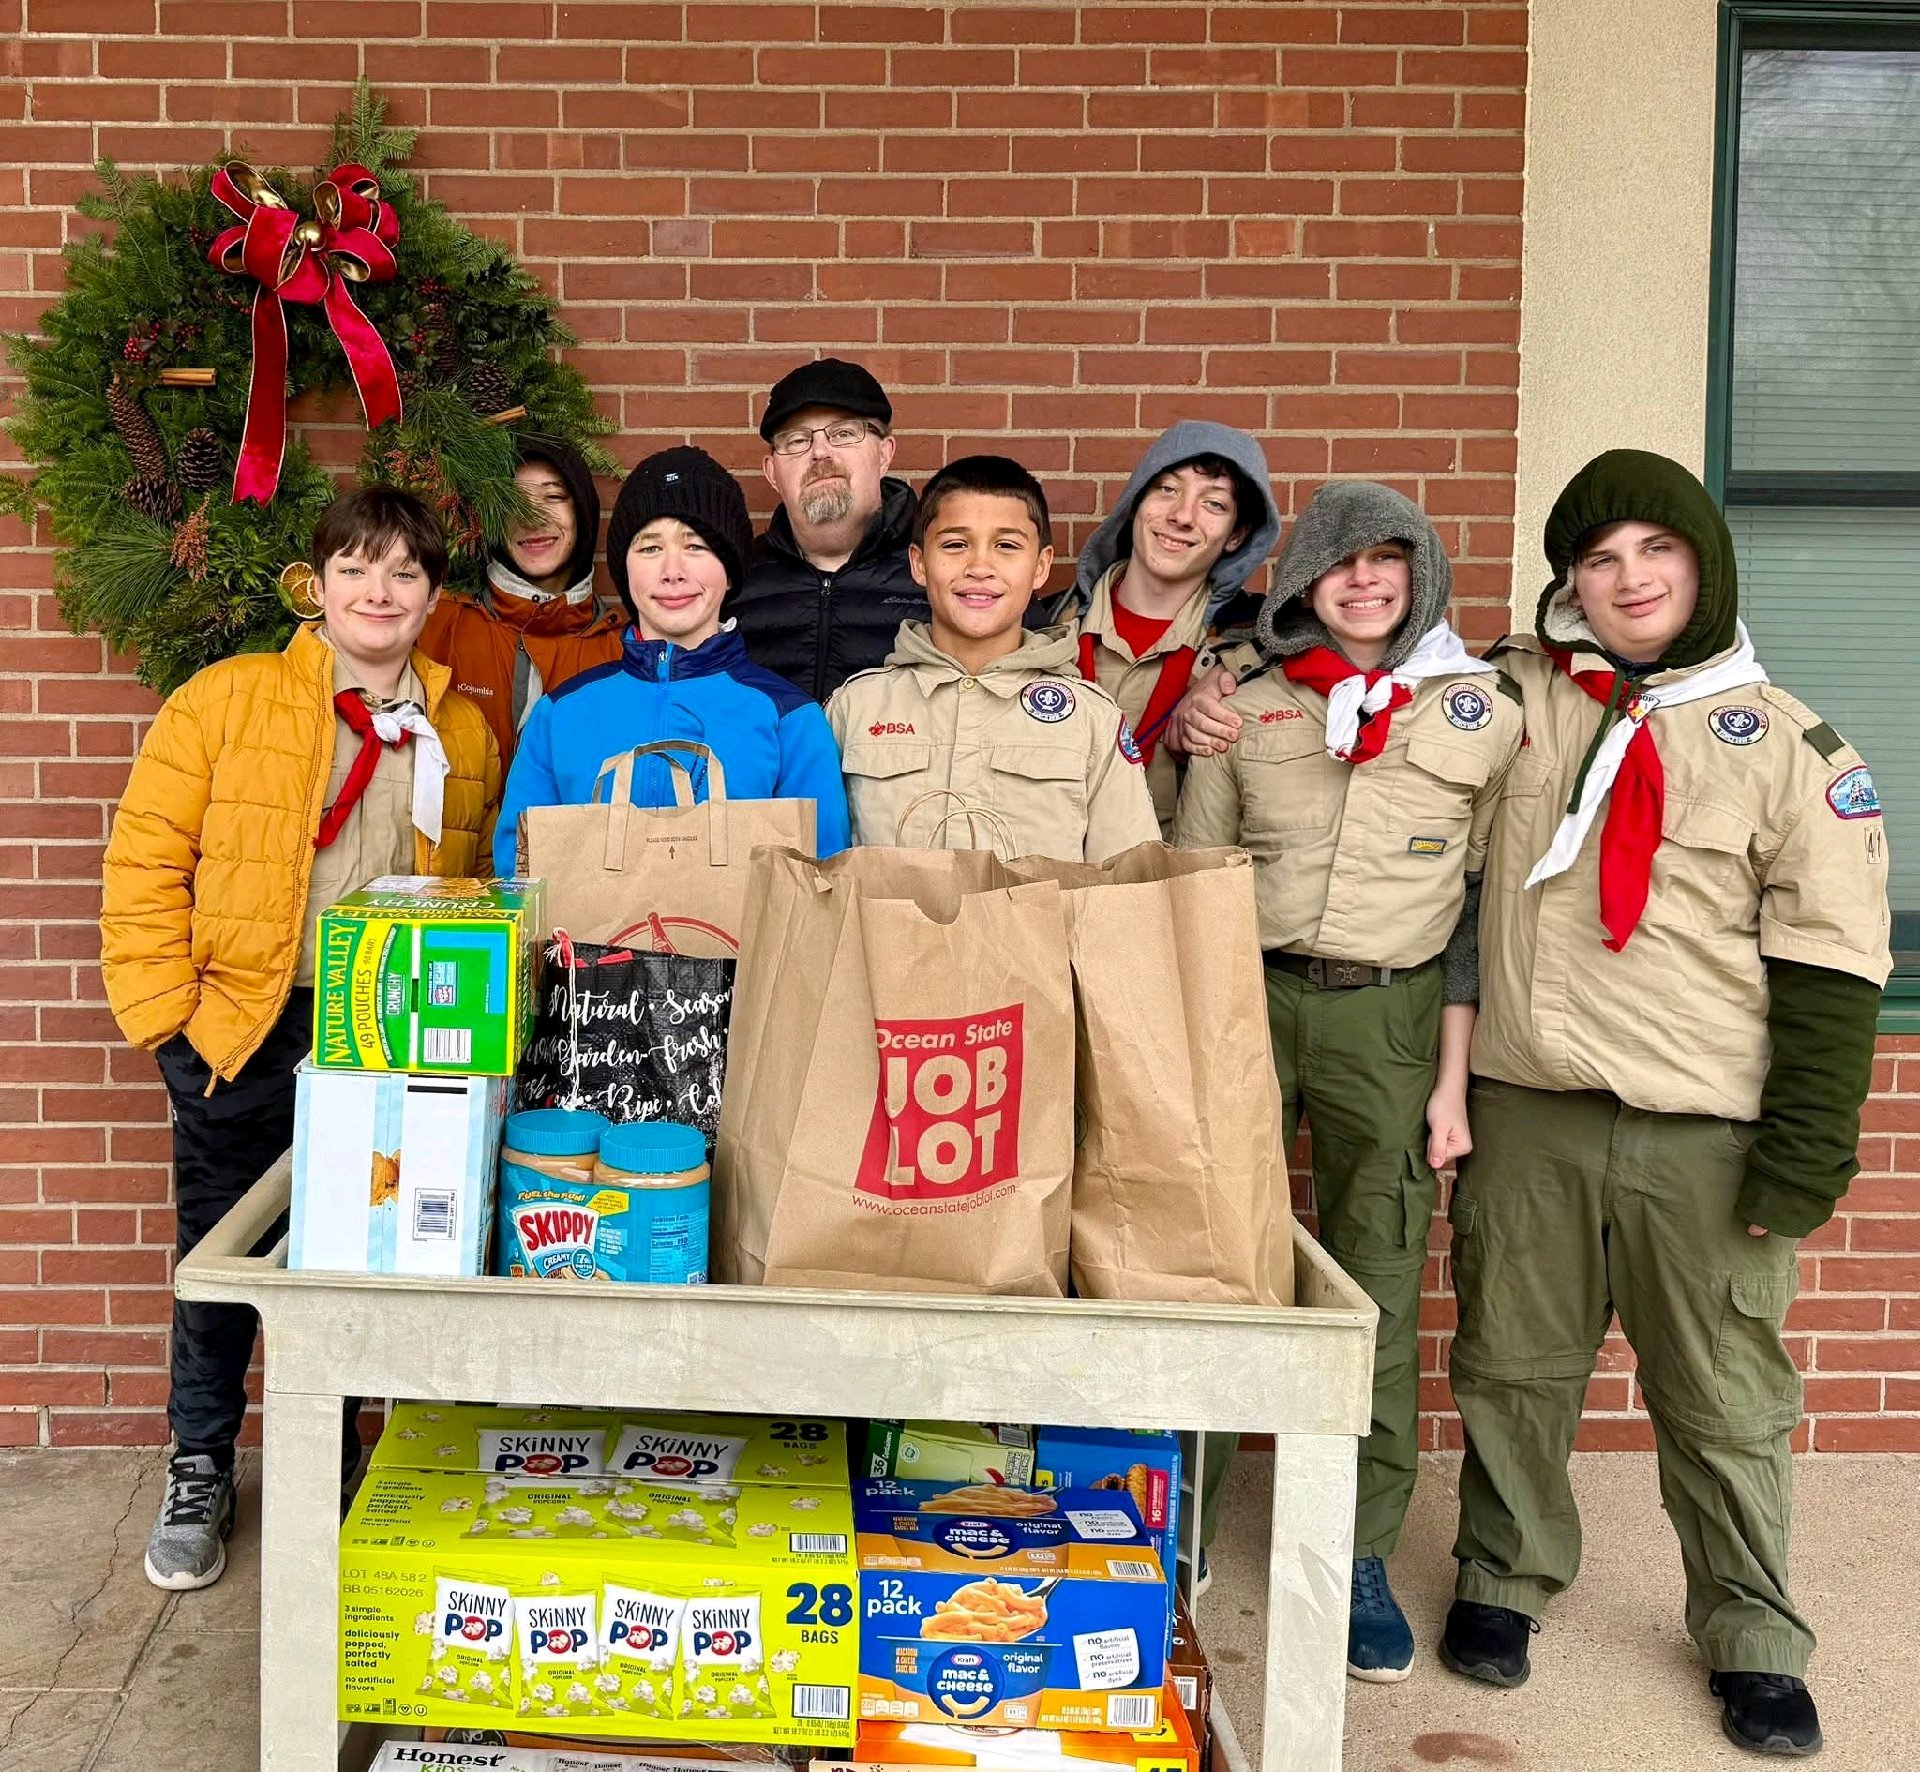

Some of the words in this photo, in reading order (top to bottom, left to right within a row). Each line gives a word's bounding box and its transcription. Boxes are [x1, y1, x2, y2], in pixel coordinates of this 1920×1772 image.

[1275, 709, 1304, 722] BSA
[886, 722, 916, 736] BSA
[327, 922, 358, 988] VALLEY
[356, 968, 372, 1030] POUCHES
[386, 972, 401, 1016] CRUNCHY
[324, 990, 353, 1065] NATURE
[875, 1028, 955, 1049] Ocean
[964, 1019, 1012, 1045] State
[360, 1032, 375, 1049] 49
[883, 1045, 1007, 1118] JOB
[883, 1110, 1002, 1186] LOT
[852, 1183, 1016, 1216] www.oceanstatejoblot.com
[519, 1210, 595, 1251] SKIPPY
[543, 1253, 571, 1270] CREAMY
[769, 1421, 830, 1442] 28
[783, 1441, 818, 1450] BAGS
[494, 1454, 589, 1476] POP
[623, 1451, 719, 1479] POP
[873, 1459, 885, 1475] 36
[875, 1480, 897, 1489] 12
[648, 1492, 691, 1503] ORIGINAL
[865, 1487, 916, 1497] pack
[1152, 1509, 1162, 1523] 16
[950, 1528, 987, 1537] mac
[989, 1529, 1003, 1537] &
[342, 1568, 368, 1579] LOT
[343, 1584, 361, 1594] BB
[878, 1579, 904, 1599] 12
[351, 1606, 381, 1615] simple
[786, 1582, 853, 1627] 28
[867, 1595, 922, 1618] pack
[344, 1613, 394, 1622] ingredients
[444, 1613, 503, 1642] POP
[345, 1629, 400, 1641] deliciously
[530, 1628, 588, 1654] POP
[609, 1620, 668, 1651] POP
[801, 1630, 839, 1644] BAGS
[1087, 1637, 1103, 1645] no
[1103, 1635, 1130, 1644] artificial
[345, 1641, 387, 1650] popped,
[693, 1630, 752, 1656] POP
[345, 1650, 391, 1660] perfectly
[456, 1654, 483, 1663] ORIGINAL
[1002, 1652, 1043, 1663] original
[1089, 1653, 1104, 1661] no
[345, 1660, 377, 1668] salted
[619, 1662, 646, 1674] ORIGINAL
[1007, 1662, 1041, 1674] flavor
[358, 1676, 395, 1684] artificial
[942, 1669, 977, 1680] mac
[978, 1669, 990, 1681] &
[1093, 1671, 1107, 1679] no
[394, 1747, 507, 1767] Honest
